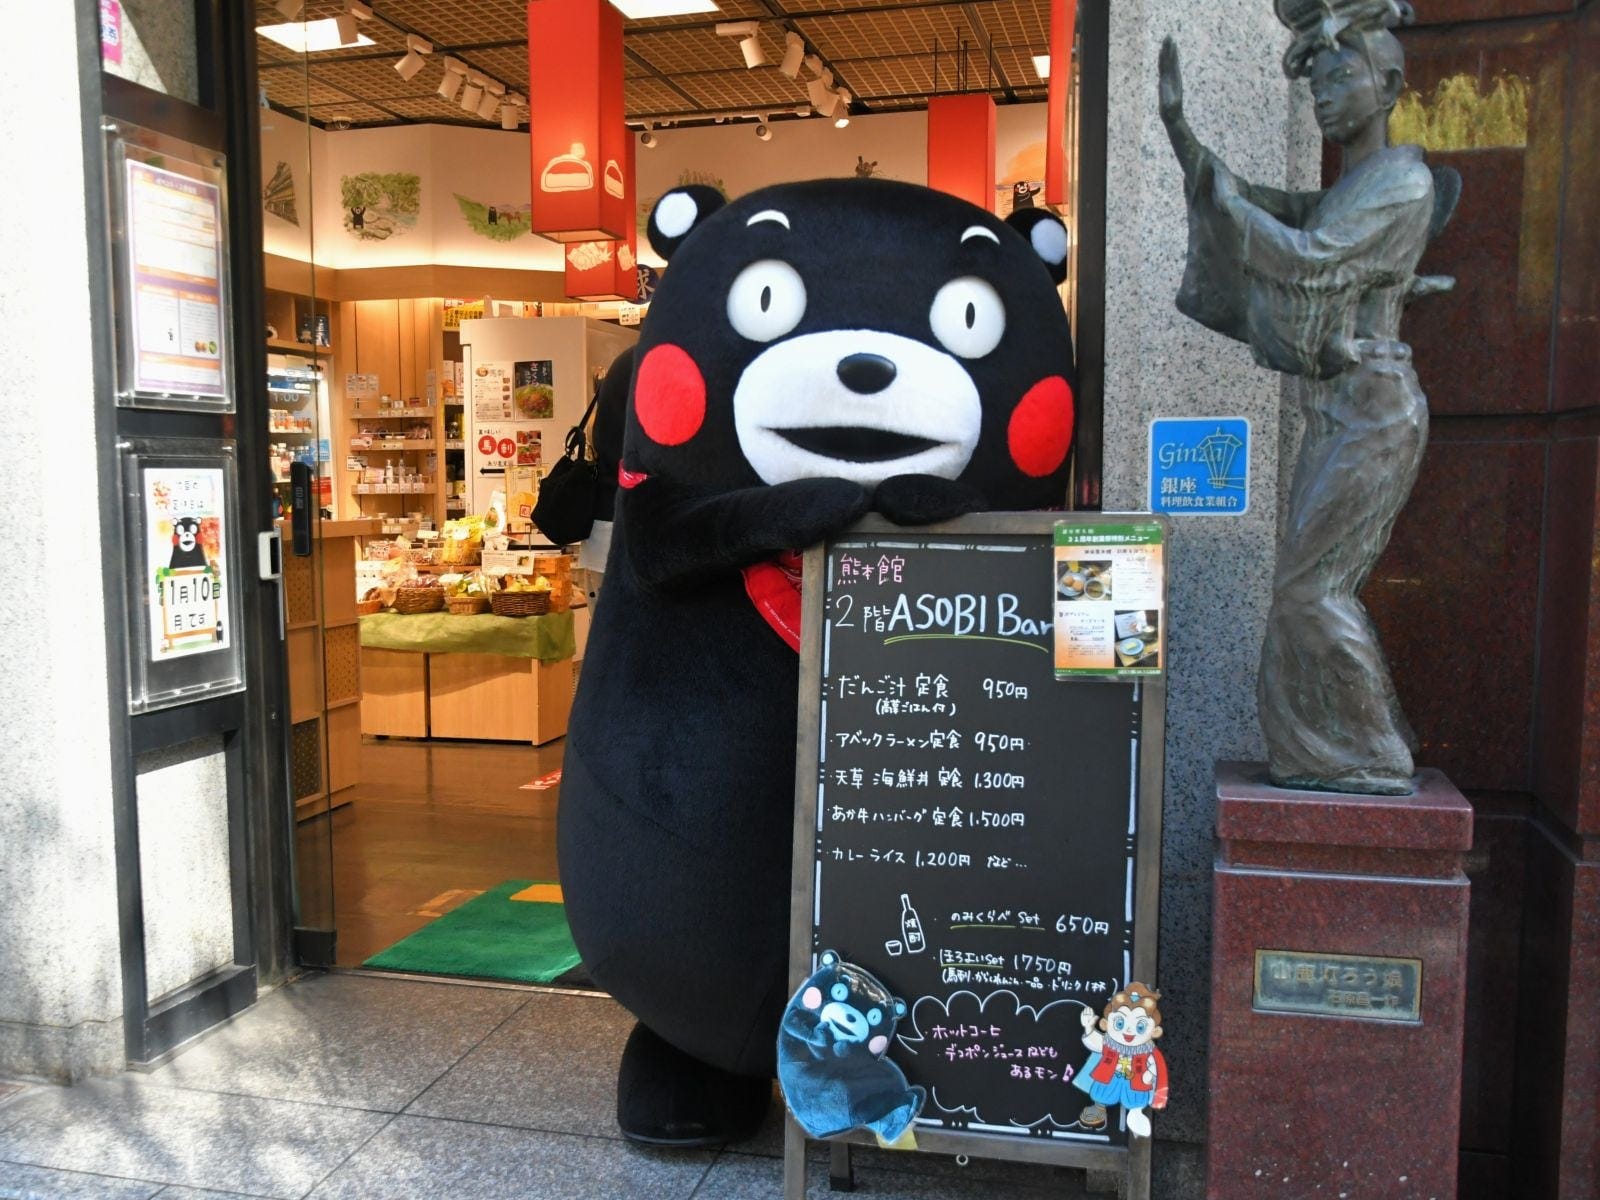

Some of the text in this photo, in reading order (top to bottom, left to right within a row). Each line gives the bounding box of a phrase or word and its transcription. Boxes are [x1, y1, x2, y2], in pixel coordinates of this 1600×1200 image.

[1160, 476, 1197, 494] 銀座
[837, 552, 906, 586] 熊本館
[834, 594, 893, 634] 2階
[887, 593, 987, 636] ASOBI
[837, 671, 1029, 701] だんご汁 定食 950円
[974, 731, 1025, 753] 950円
[834, 766, 865, 790] 天草
[937, 765, 964, 789] 定食
[831, 804, 870, 825] あか牛
[872, 807, 928, 823] ハンバーグ
[931, 805, 964, 828] 定食
[1055, 914, 1110, 935] 650円
[1013, 953, 1072, 976] 1750円
[1009, 1063, 1058, 1080] あるモン
